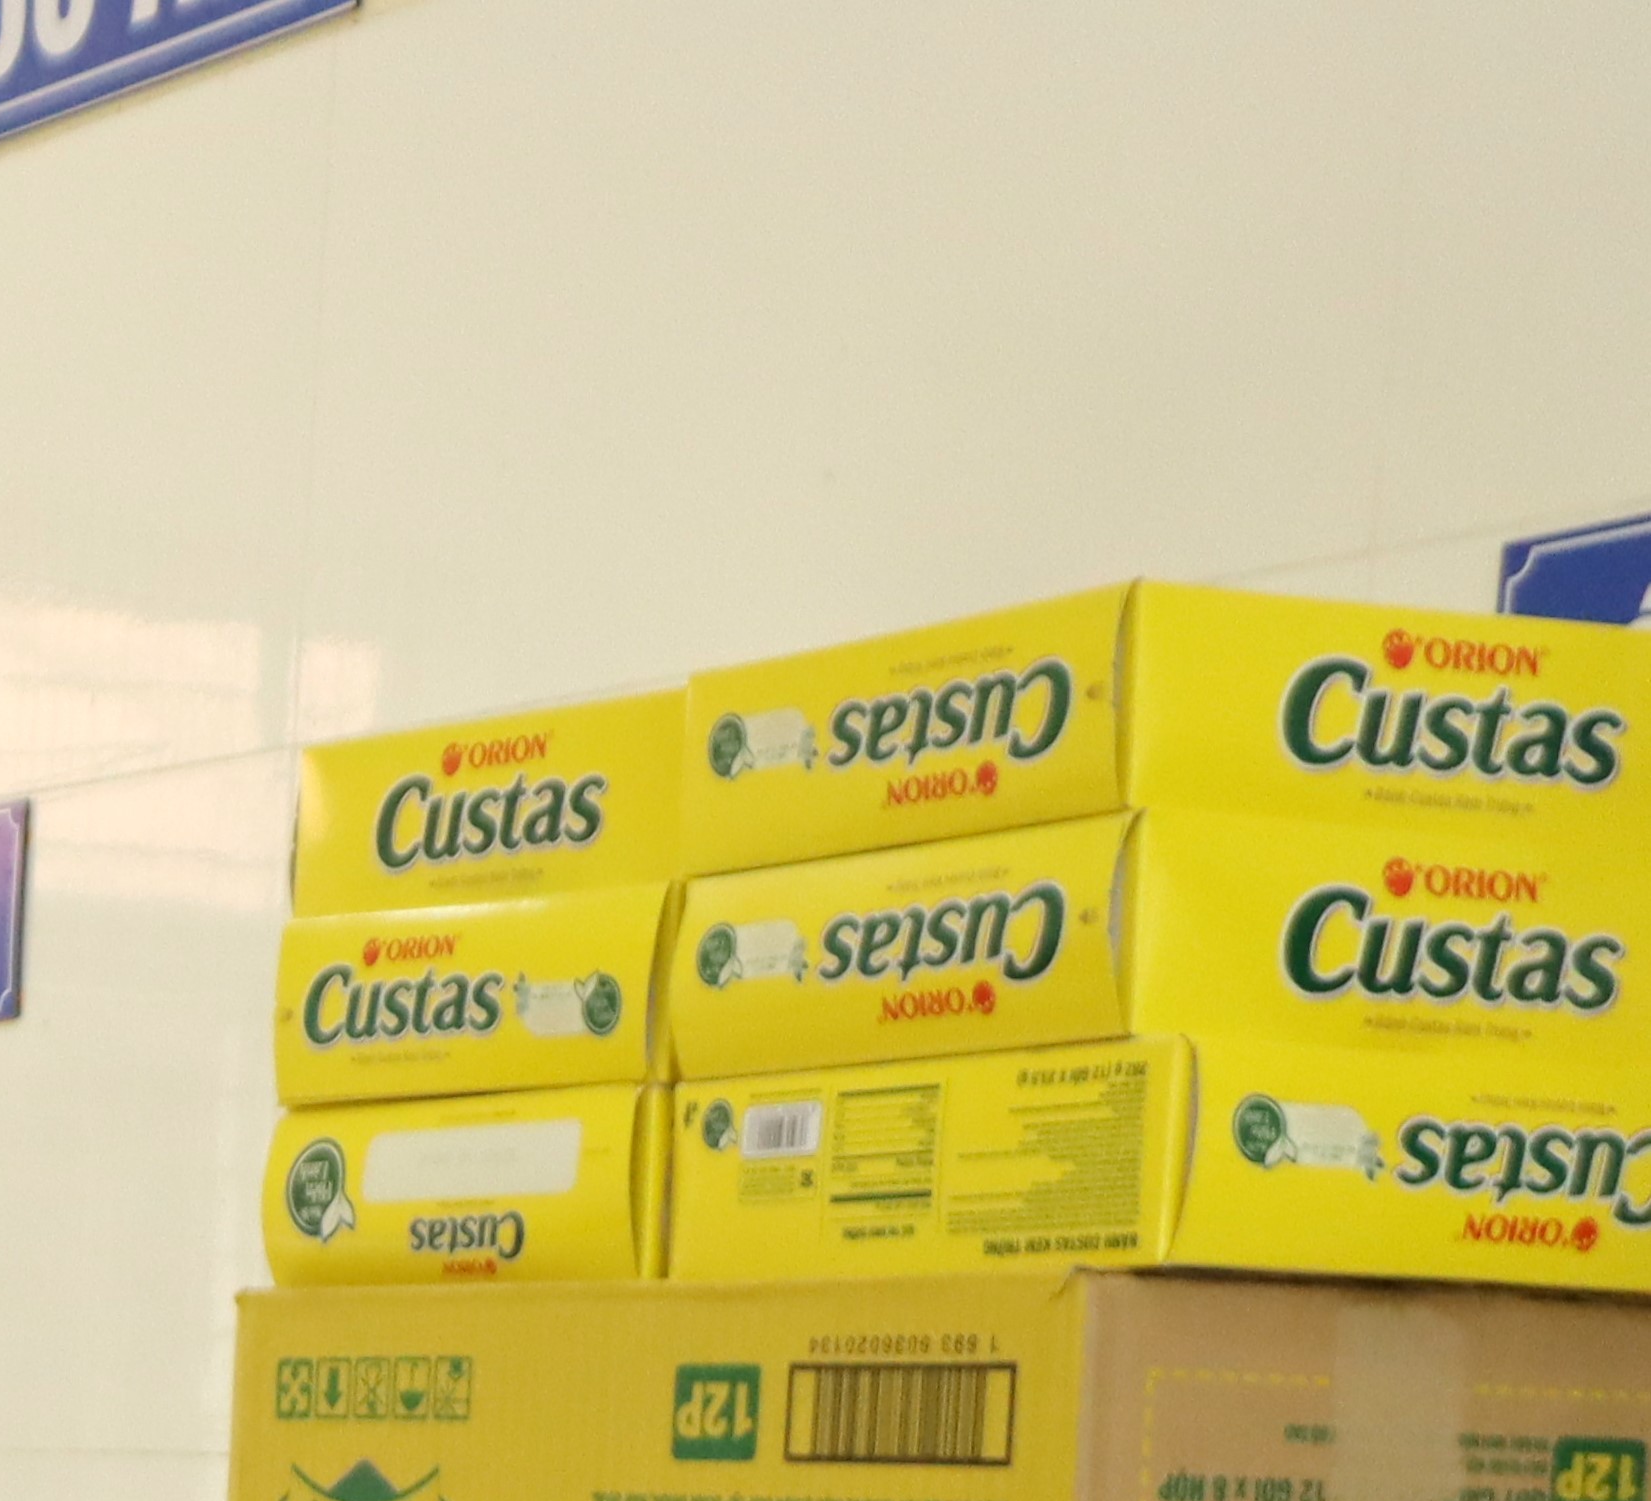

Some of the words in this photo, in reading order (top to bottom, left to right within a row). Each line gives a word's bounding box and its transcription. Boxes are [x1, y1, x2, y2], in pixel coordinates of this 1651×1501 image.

[1425, 638, 1540, 678] ORION
[826, 656, 1072, 768] Custas
[1279, 656, 1628, 790] Custas
[468, 731, 549, 769] ORION
[887, 769, 969, 806] ORION
[375, 772, 608, 872] Custas
[1425, 869, 1540, 904] ORION
[386, 934, 456, 962] ORION
[818, 879, 1066, 981] Custas
[1279, 882, 1627, 1012] Custas
[302, 963, 504, 1047] Custas
[881, 987, 964, 1020] ORION
[410, 1211, 525, 1260] Custas
[1462, 1213, 1564, 1246] ORION
[676, 1380, 753, 1439] 12P
